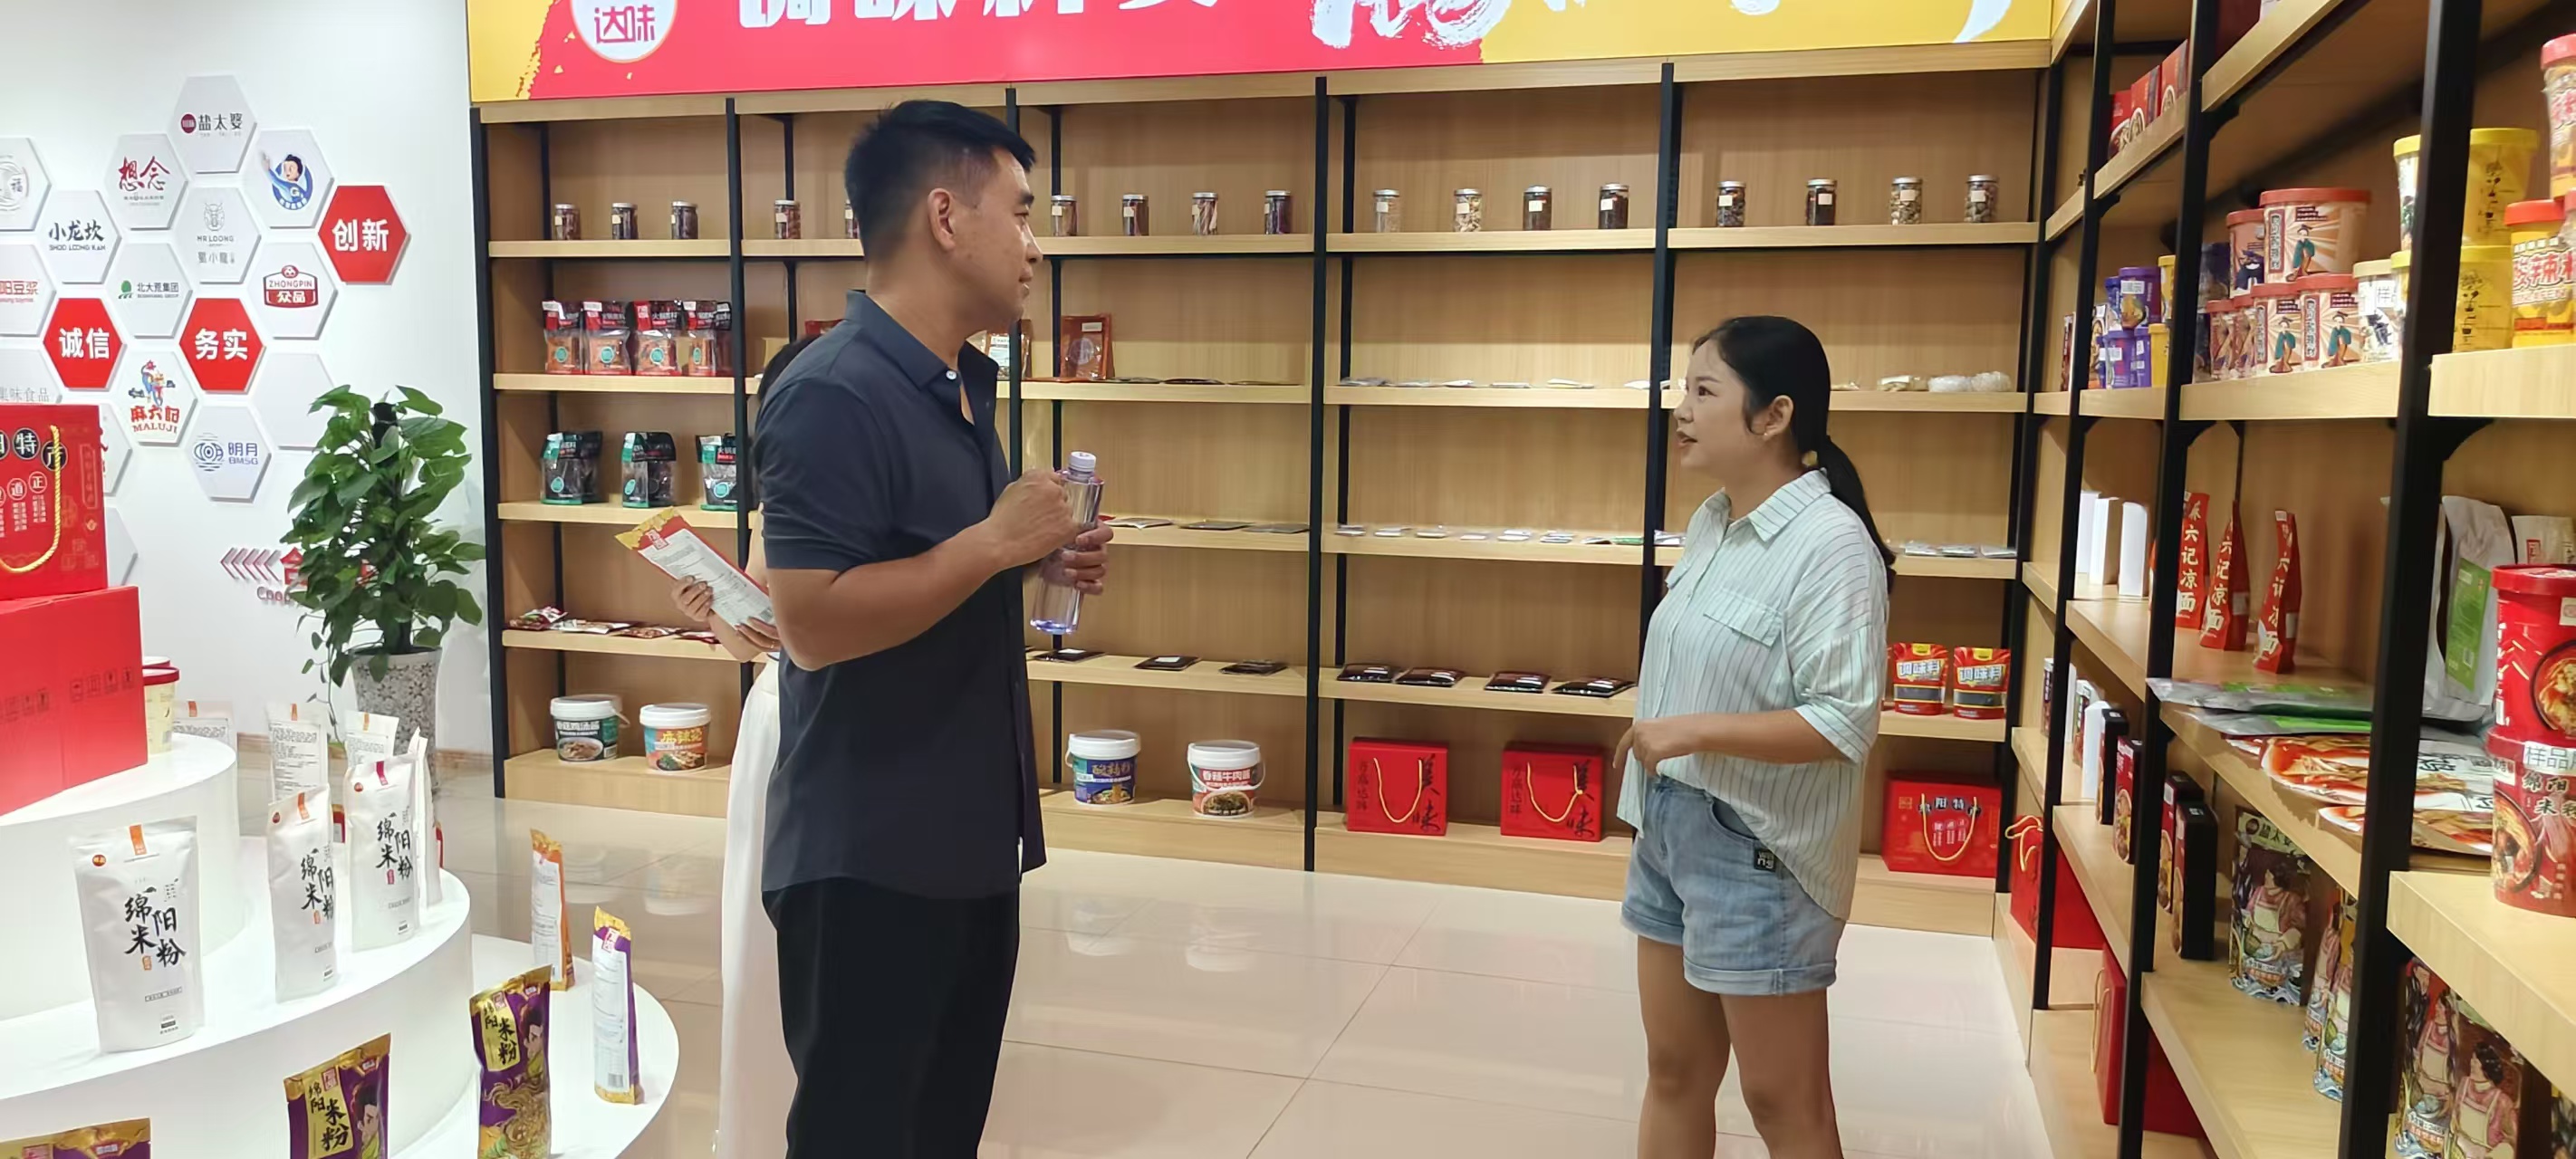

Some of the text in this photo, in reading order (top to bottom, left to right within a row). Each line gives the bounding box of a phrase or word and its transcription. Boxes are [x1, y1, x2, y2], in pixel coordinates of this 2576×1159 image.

[593, 5, 656, 43] 达味
[197, 112, 243, 131] 盐太婆
[118, 155, 170, 192] 想念
[48, 219, 104, 242] 小龙坎
[332, 219, 389, 253] 创新
[137, 282, 179, 292] 北大荒集团
[269, 280, 312, 288] ZHONGPIN
[276, 291, 306, 303] 众品
[59, 327, 110, 359] 诚信
[195, 329, 248, 360] 务实
[130, 405, 180, 423] 麻六记
[132, 422, 178, 434] MALUJI
[227, 442, 258, 456] 明月
[2206, 519, 2233, 632] 六记凉面
[2522, 771, 2569, 792] 绵阳
[498, 1017, 517, 1066] 米粉
[322, 1098, 350, 1151] 米粉
